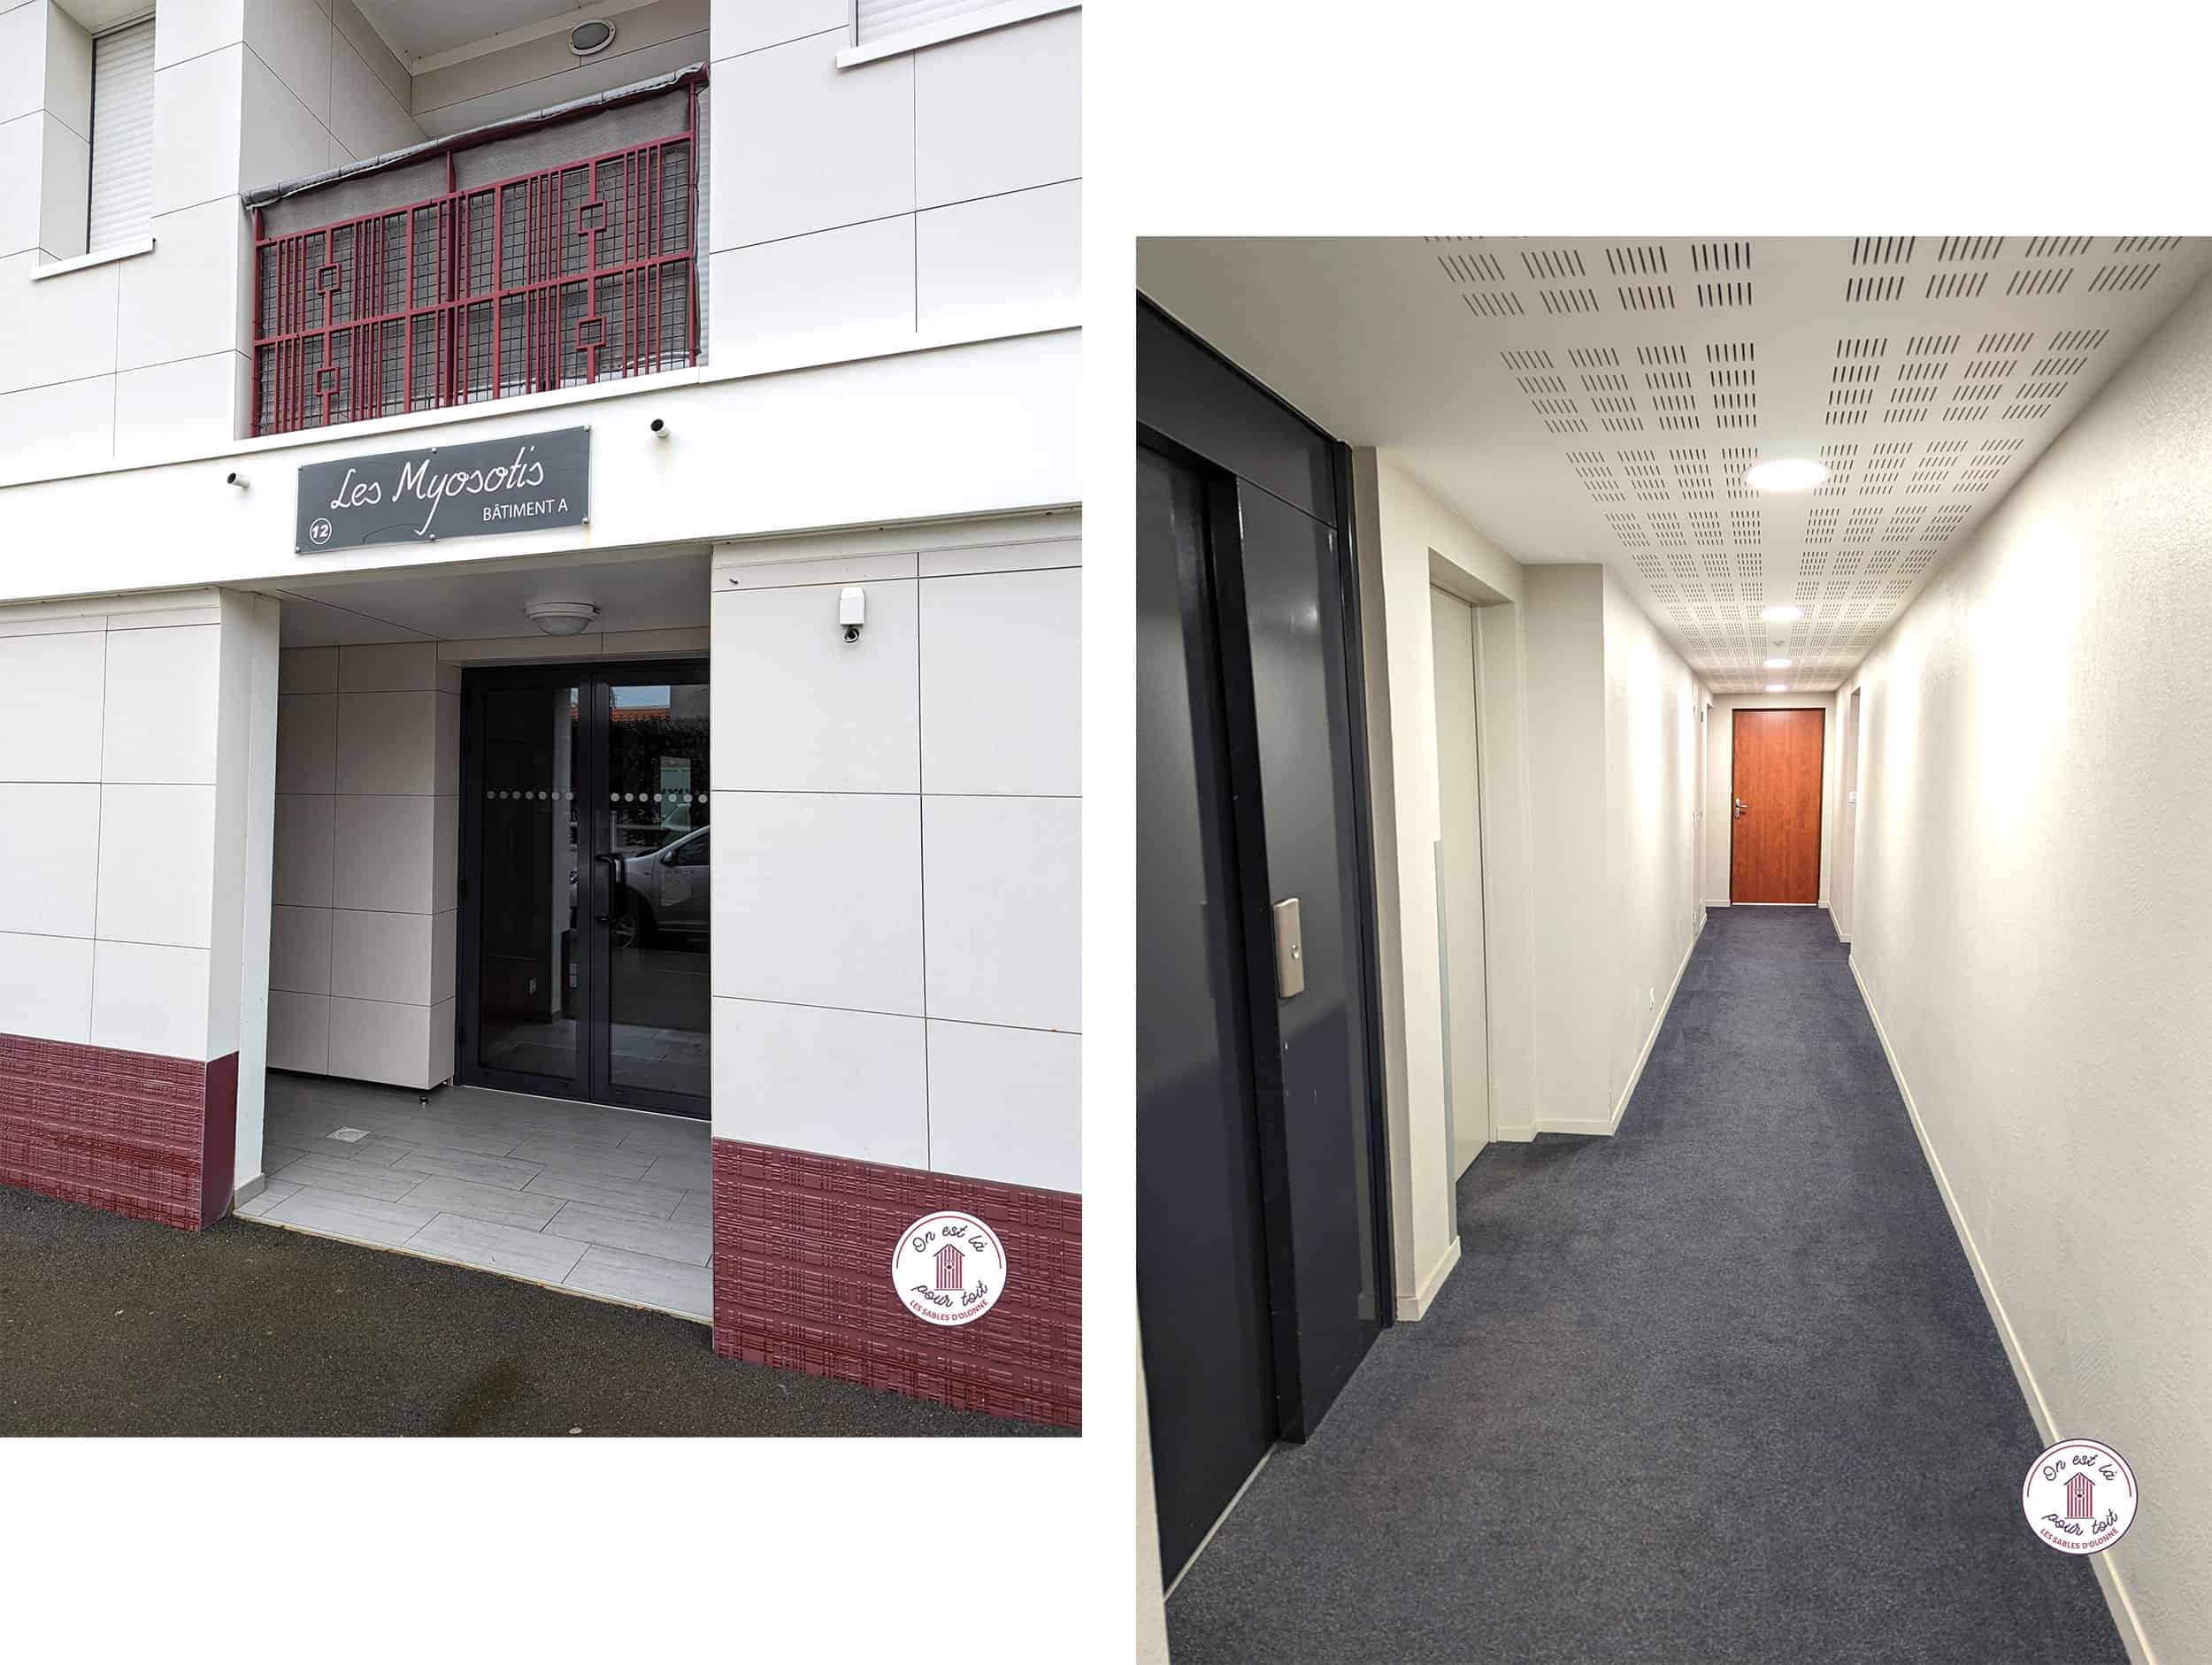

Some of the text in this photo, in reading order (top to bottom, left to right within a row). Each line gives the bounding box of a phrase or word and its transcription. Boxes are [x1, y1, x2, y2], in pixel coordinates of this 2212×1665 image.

[330, 446, 544, 535] Les Myosotis
[483, 498, 568, 521] BÂTIMENT A
[311, 524, 330, 538] 12
